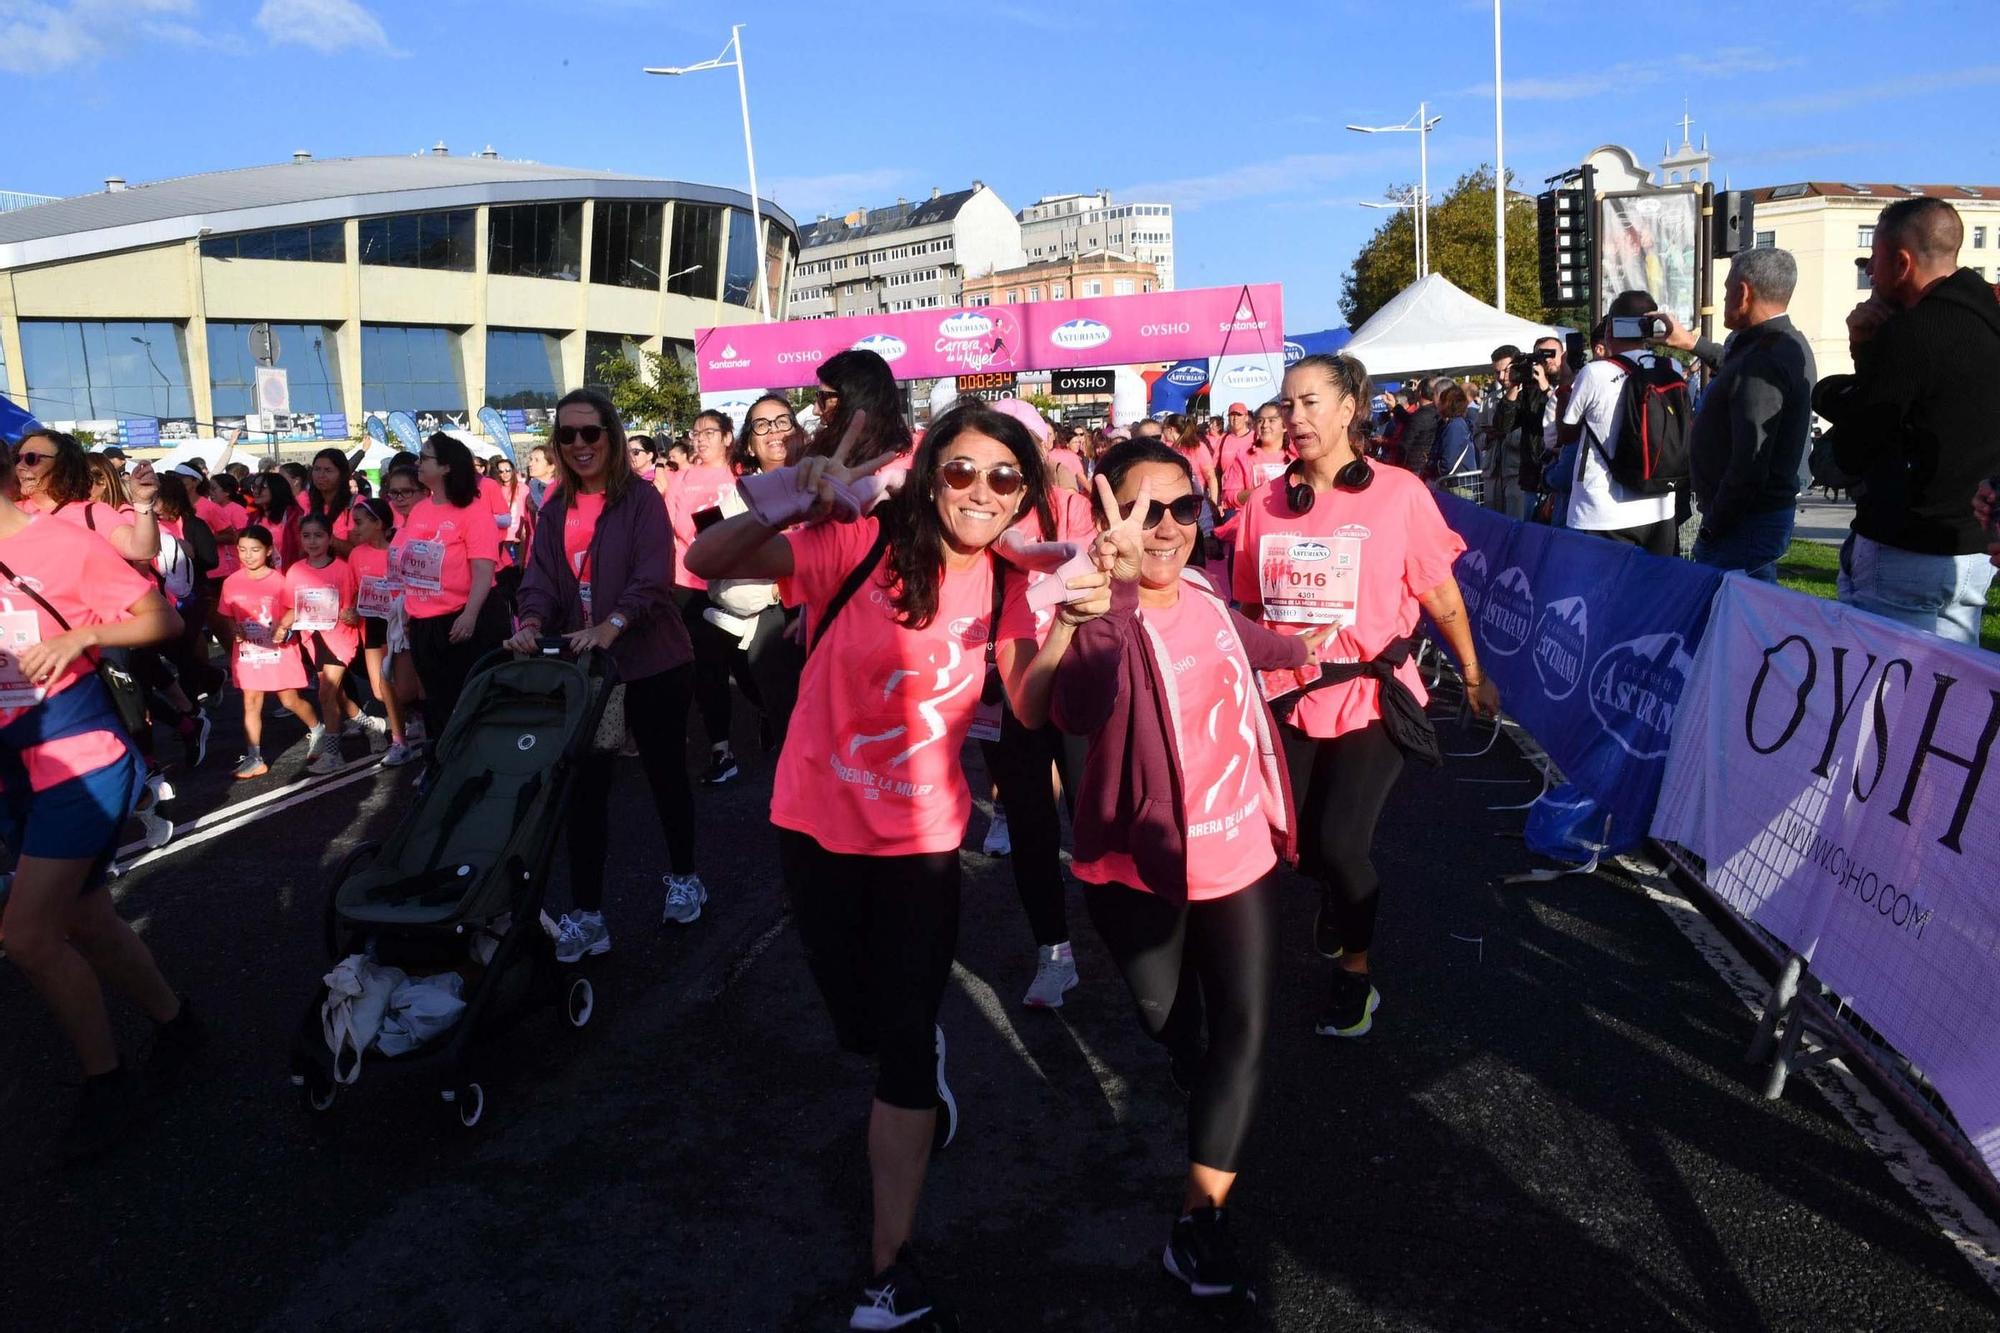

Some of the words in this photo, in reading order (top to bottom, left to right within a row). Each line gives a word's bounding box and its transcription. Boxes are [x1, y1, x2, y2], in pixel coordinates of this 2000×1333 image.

[1141, 322, 1190, 337] OYSHO
[1219, 321, 1267, 332] Santander
[1055, 330, 1107, 342] ASTURIANA
[934, 338, 980, 352] Carrera
[708, 357, 751, 370] Santander
[777, 350, 823, 364] OYSHO
[1060, 377, 1106, 389] OYSHO
[1226, 374, 1268, 384] ASTURIANA
[1290, 572, 1326, 587] 016
[1187, 819, 1223, 838] RRERA
